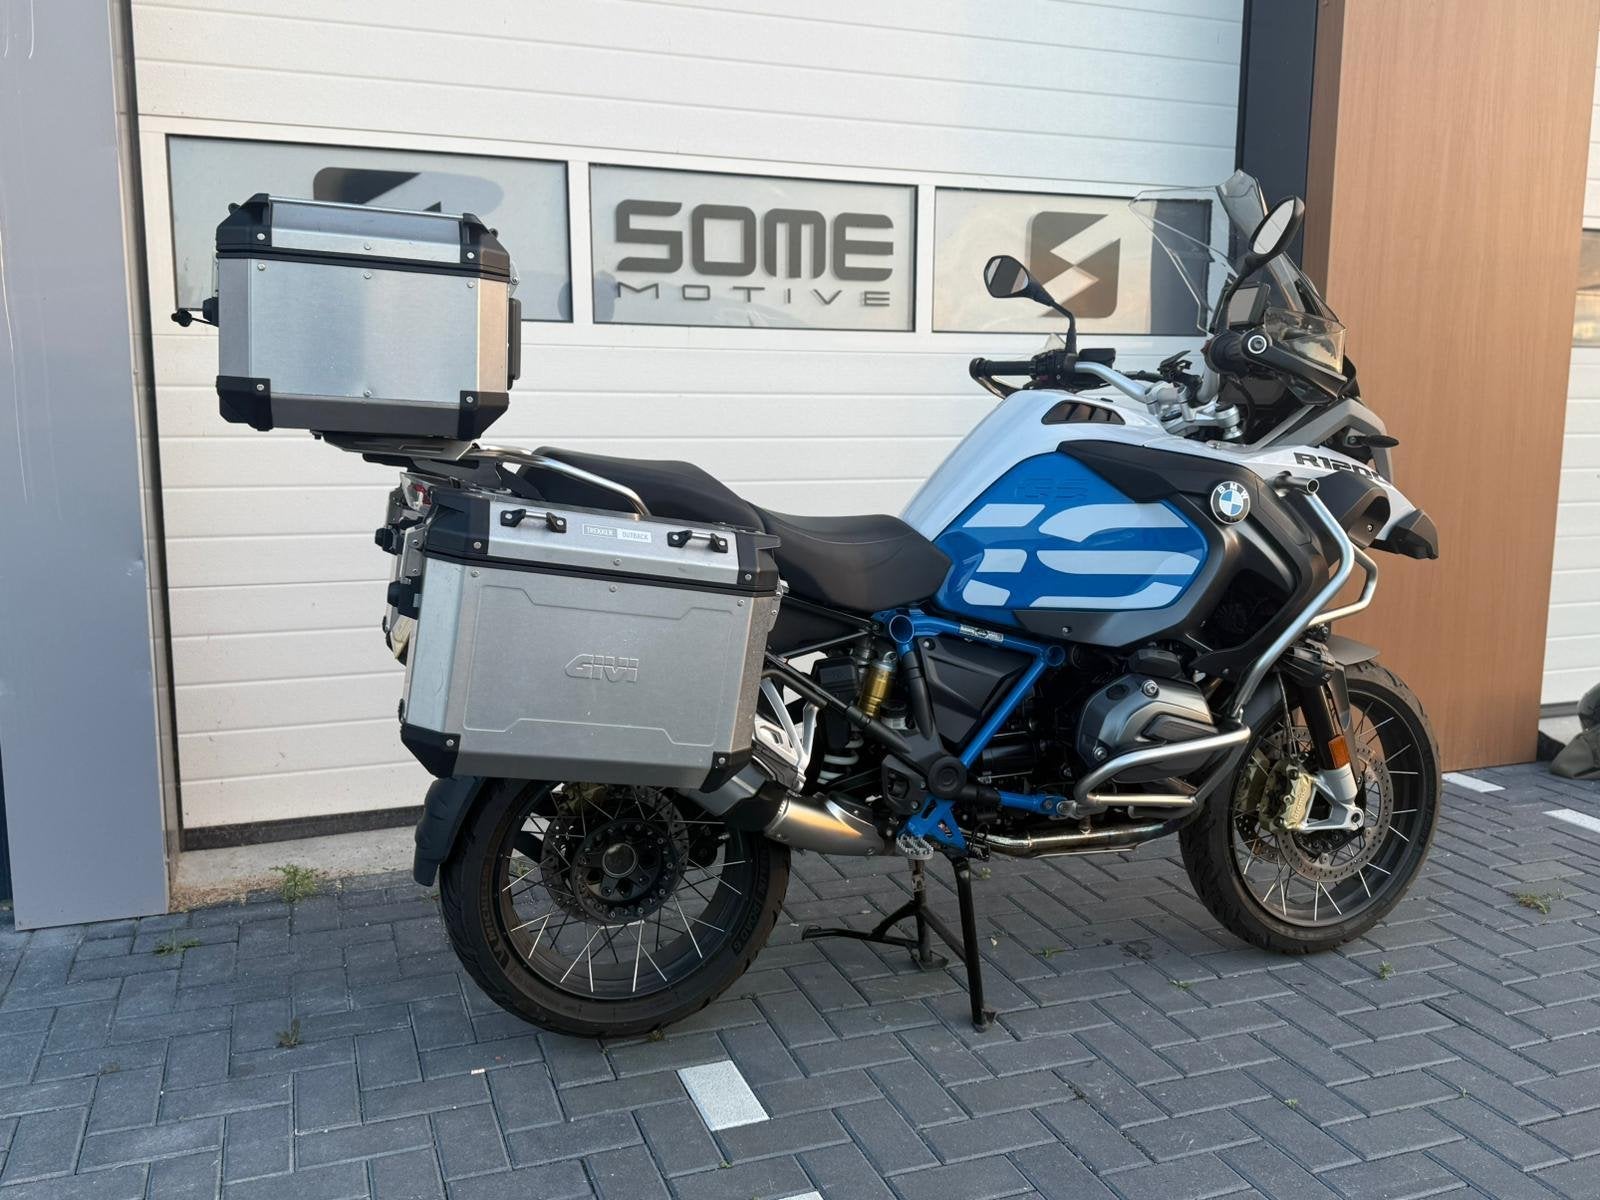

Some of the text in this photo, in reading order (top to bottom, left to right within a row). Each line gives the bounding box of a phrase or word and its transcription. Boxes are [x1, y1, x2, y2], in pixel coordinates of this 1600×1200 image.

[615, 198, 894, 282] SOME
[617, 281, 891, 307] MOTIVE
[565, 653, 639, 683] GIVI
